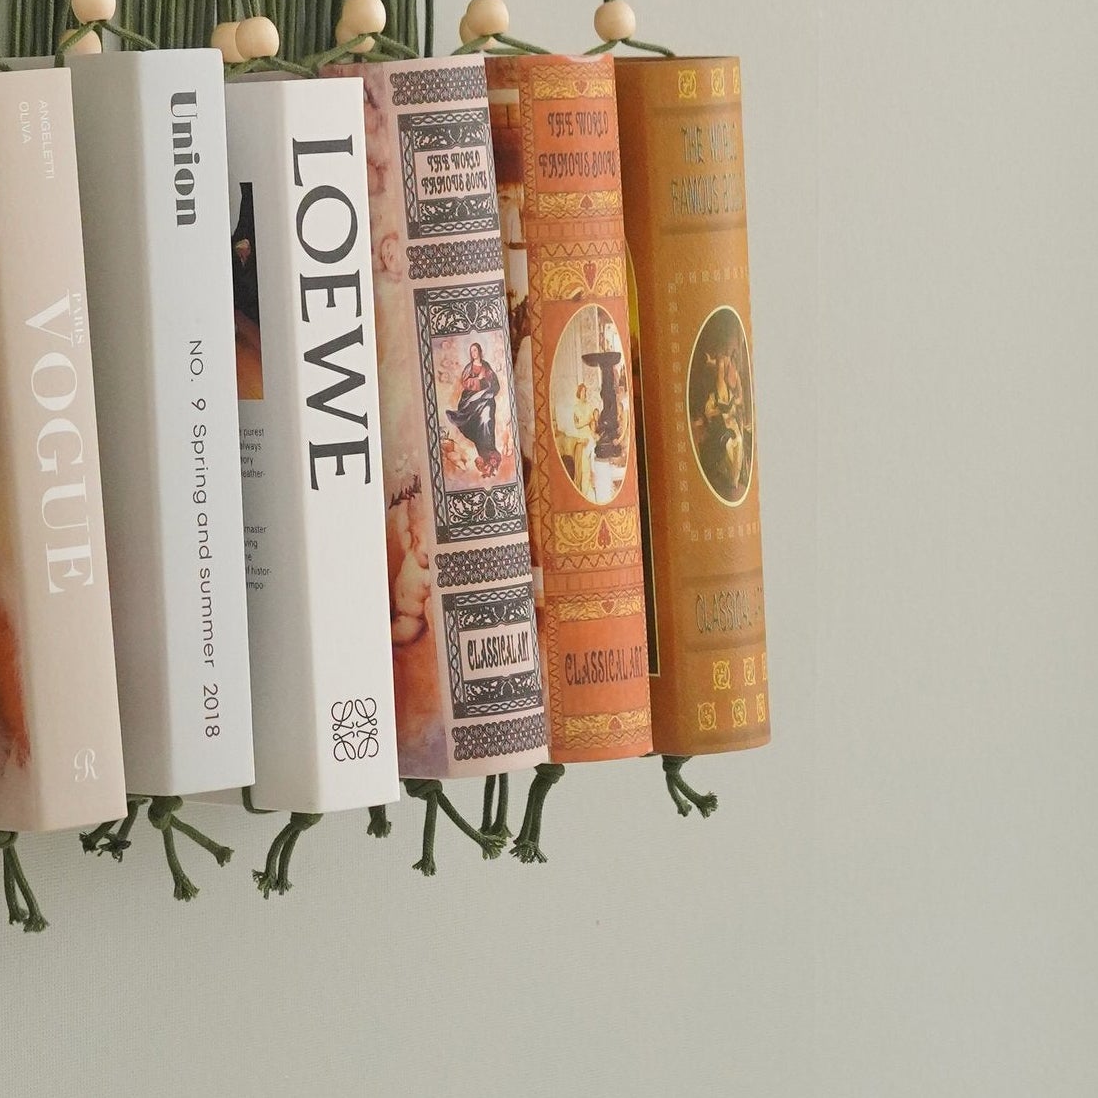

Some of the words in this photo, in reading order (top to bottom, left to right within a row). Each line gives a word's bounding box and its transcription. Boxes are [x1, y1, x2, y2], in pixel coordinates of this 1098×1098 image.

[18, 102, 32, 145] OLIVA
[39, 99, 55, 180] ANGELETTI
[547, 112, 573, 138] THE
[575, 110, 609, 138] WORLD
[170, 89, 201, 227] Union
[427, 155, 450, 173] THE
[450, 149, 481, 170] WORLD
[538, 152, 590, 179] FAMOUS
[421, 174, 464, 195] FAMOUS
[465, 169, 488, 192] BOOKS
[71, 292, 86, 346] PARIS
[292, 134, 371, 492] LOEWE
[188, 340, 204, 383] NO.
[191, 397, 207, 412] 9
[25, 289, 95, 595] VOGUE
[190, 423, 210, 505] Spring
[197, 512, 213, 560] and
[200, 567, 215, 669] summer
[467, 634, 517, 671] CLASSICAL
[565, 649, 628, 686] CLASSICAL
[203, 683, 221, 739] 2018
